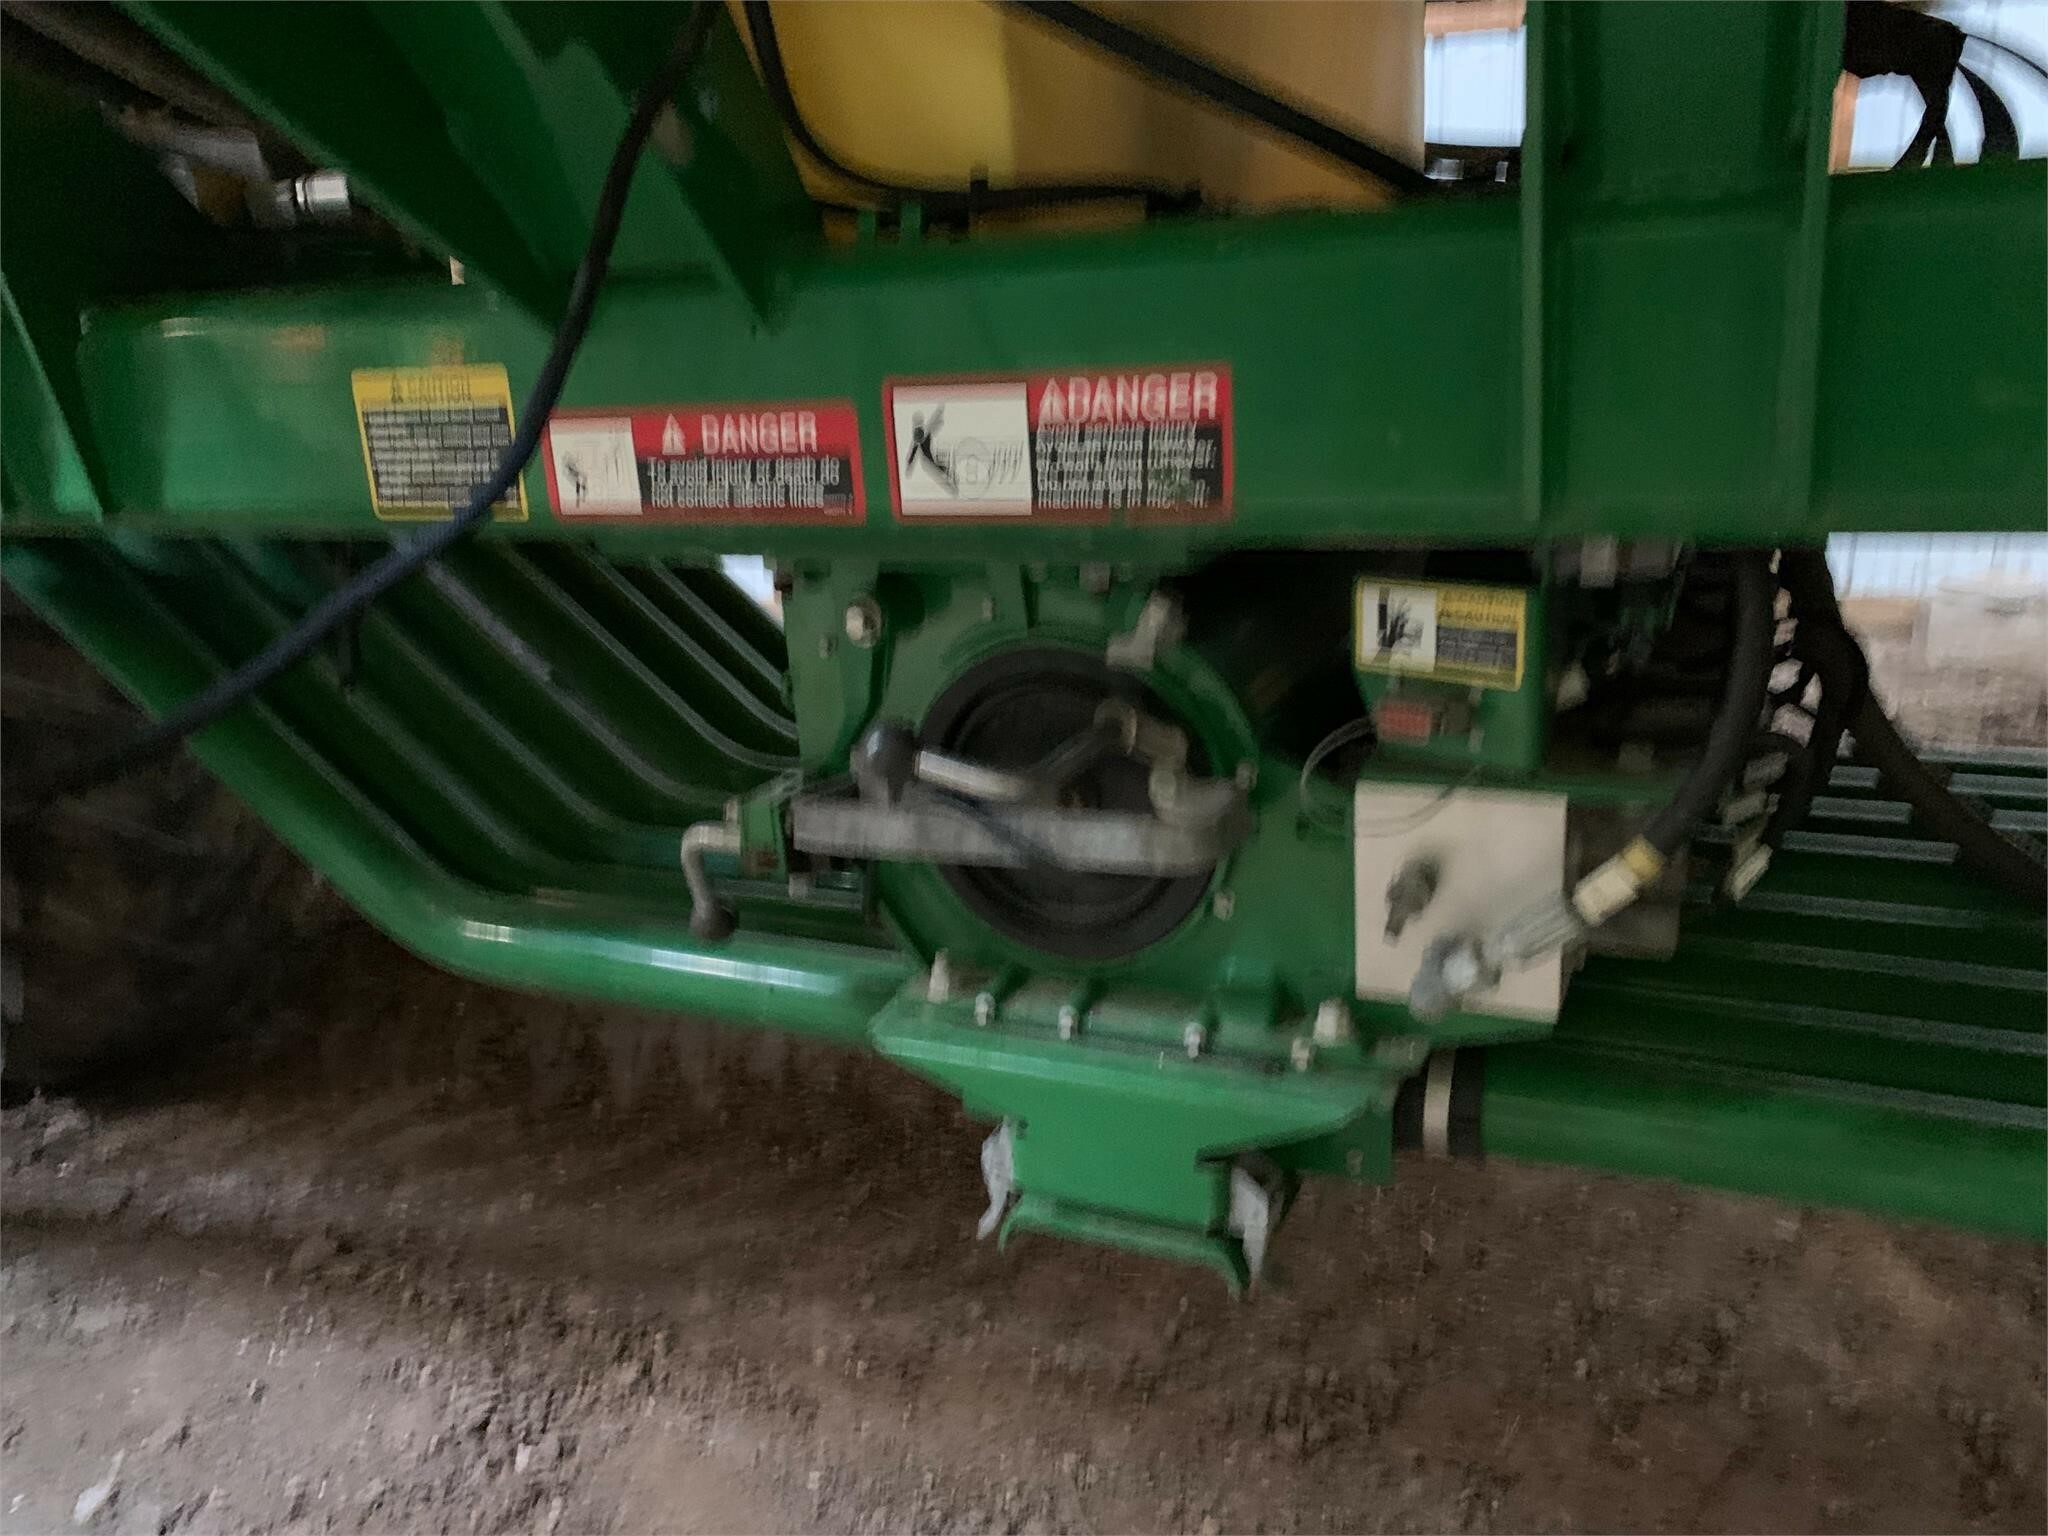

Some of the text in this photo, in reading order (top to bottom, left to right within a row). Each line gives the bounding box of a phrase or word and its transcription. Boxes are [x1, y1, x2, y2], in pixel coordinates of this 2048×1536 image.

[407, 376, 472, 402] CAUTION
[1067, 372, 1218, 422] DANGER
[701, 411, 819, 455] DANGER
[647, 455, 841, 489] To avoid injury or death do
[651, 482, 674, 508] not
[677, 482, 730, 508] contact
[733, 482, 786, 508] electric
[789, 482, 825, 508] lines
